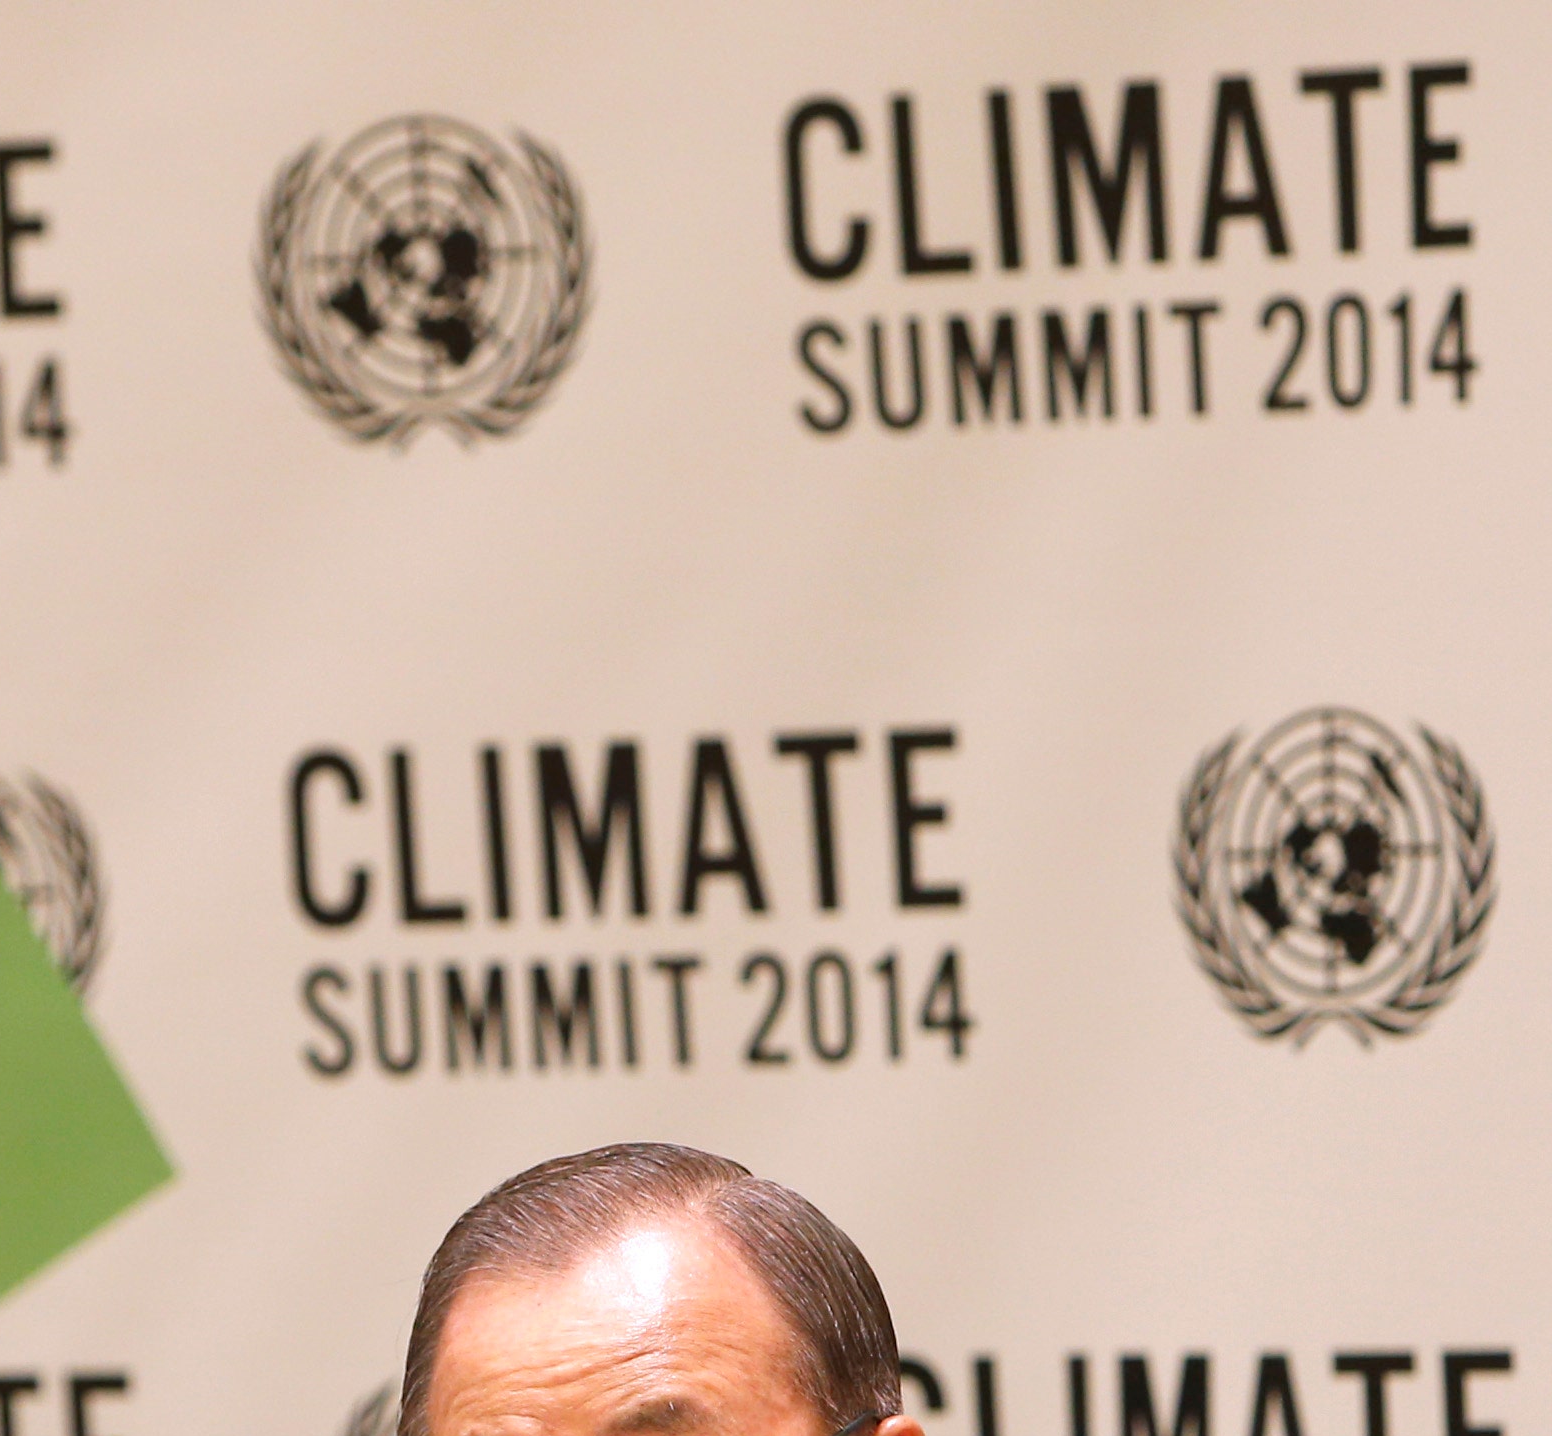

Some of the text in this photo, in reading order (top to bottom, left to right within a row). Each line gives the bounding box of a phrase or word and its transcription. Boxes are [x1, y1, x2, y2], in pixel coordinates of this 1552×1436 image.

[785, 60, 1473, 281] CLIMATE
[796, 286, 1478, 433] SUMMIT 2014
[287, 728, 965, 929] CLIMATE
[301, 949, 975, 1077] SUMMIT 2014
